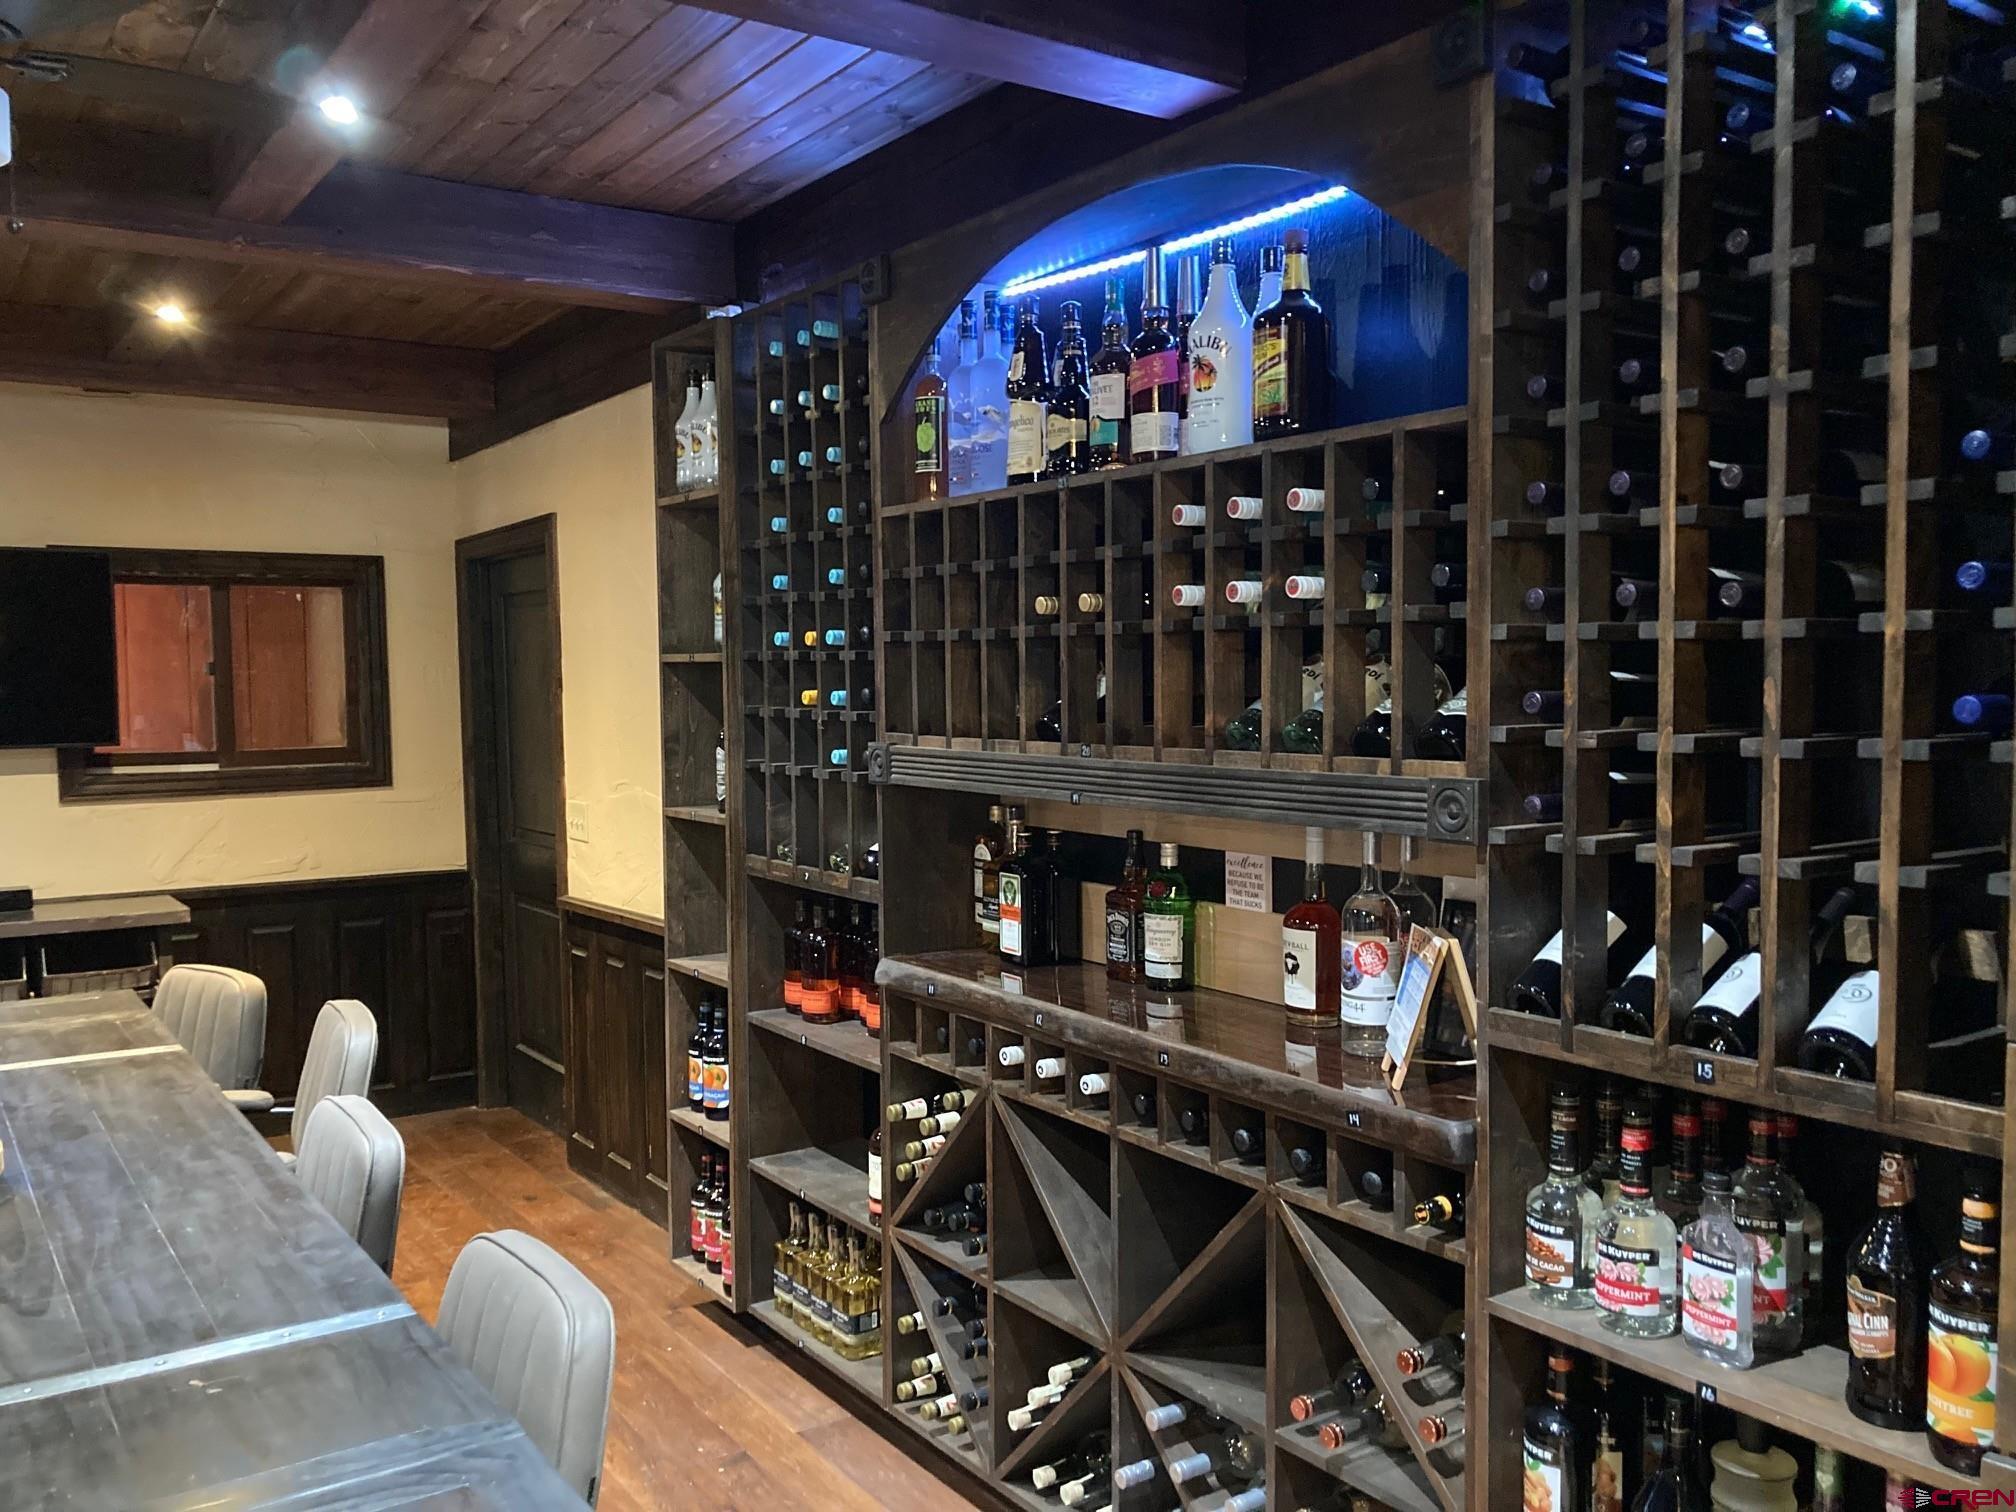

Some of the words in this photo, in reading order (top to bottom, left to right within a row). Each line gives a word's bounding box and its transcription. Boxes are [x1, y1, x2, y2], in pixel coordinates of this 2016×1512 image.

[1228, 870, 1252, 880] BECAUSE
[1254, 873, 1262, 881] WE
[1226, 879, 1247, 889] REFUSE
[1257, 883, 1264, 891] BE
[1230, 898, 1243, 906] THAT
[1232, 889, 1242, 897] THE
[1244, 891, 1259, 899] TEAM
[1359, 943, 1377, 956] USE
[1359, 949, 1386, 966] FIRST
[1697, 1062, 1713, 1079] 15
[1349, 1112, 1360, 1127] 14
[1530, 1216, 1564, 1235] KUYPER
[1607, 1244, 1651, 1262] KUYPER
[1539, 1259, 1566, 1273] CACAO
[1702, 1254, 1735, 1270] KUYPER
[1685, 1303, 1732, 1328] PEPPERMINT
[1863, 1311, 1890, 1330] CINN
[1934, 1306, 1991, 1334] KUYPER
[1701, 1385, 1715, 1402] 16
